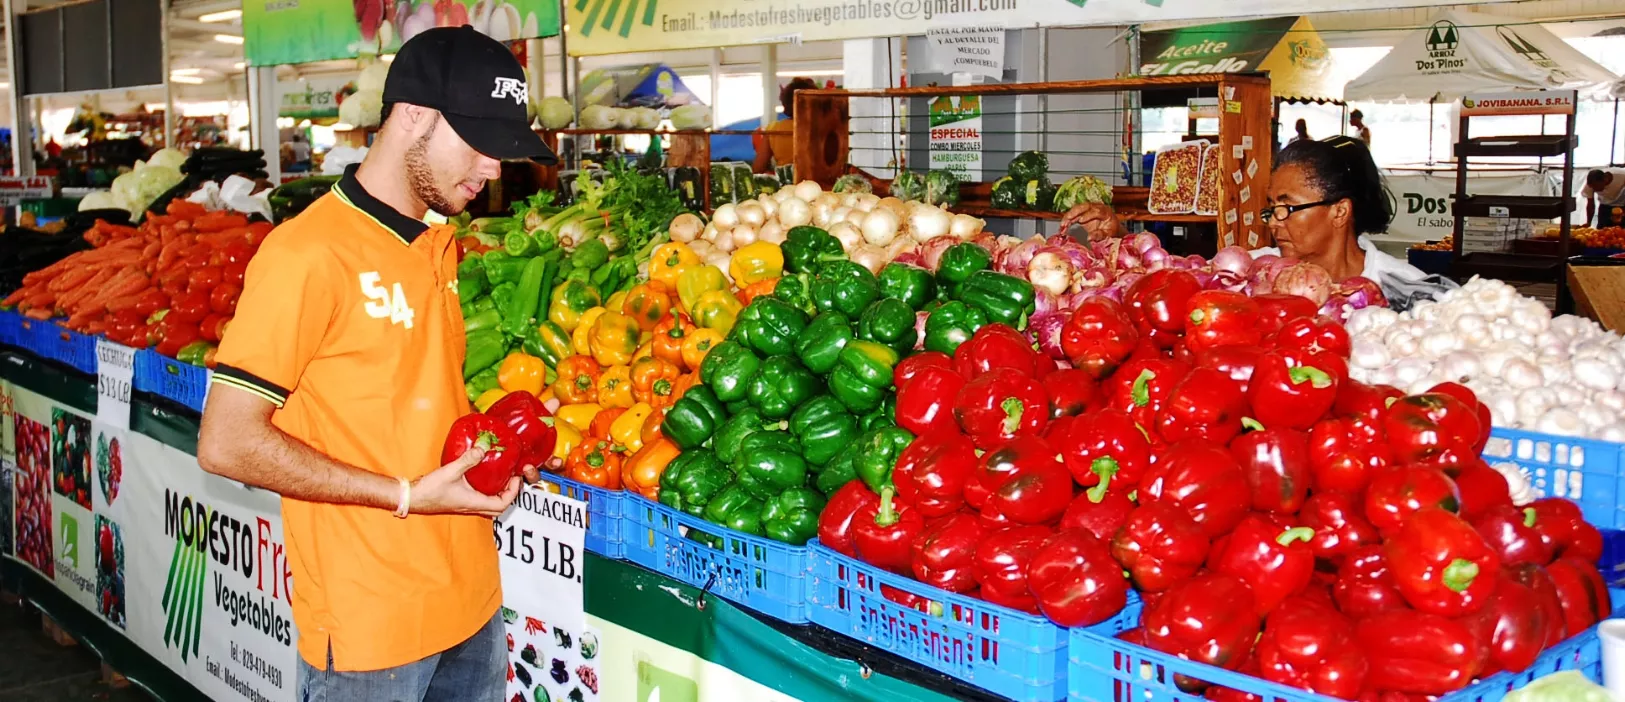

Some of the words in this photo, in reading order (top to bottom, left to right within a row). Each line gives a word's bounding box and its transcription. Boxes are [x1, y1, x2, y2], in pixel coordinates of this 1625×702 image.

[957, 46, 991, 55] MERCADO
[1156, 39, 1228, 59] Aceite
[1429, 49, 1455, 58] ARROZ
[1168, 57, 1248, 75] Gallo
[1415, 60, 1435, 70] Dos
[1435, 58, 1464, 69] Pinos
[931, 128, 979, 139] ESPECIAL
[930, 142, 949, 151] COMBO
[932, 153, 979, 162] HAMBURGUESA
[1403, 193, 1447, 214] Dos
[1417, 217, 1426, 227] El
[1429, 217, 1453, 228] sabo
[359, 271, 415, 329] 54
[165, 488, 253, 578] MODESTO
[492, 516, 535, 564] $15
[542, 536, 581, 583] LB.
[214, 570, 291, 647] Vegetables
